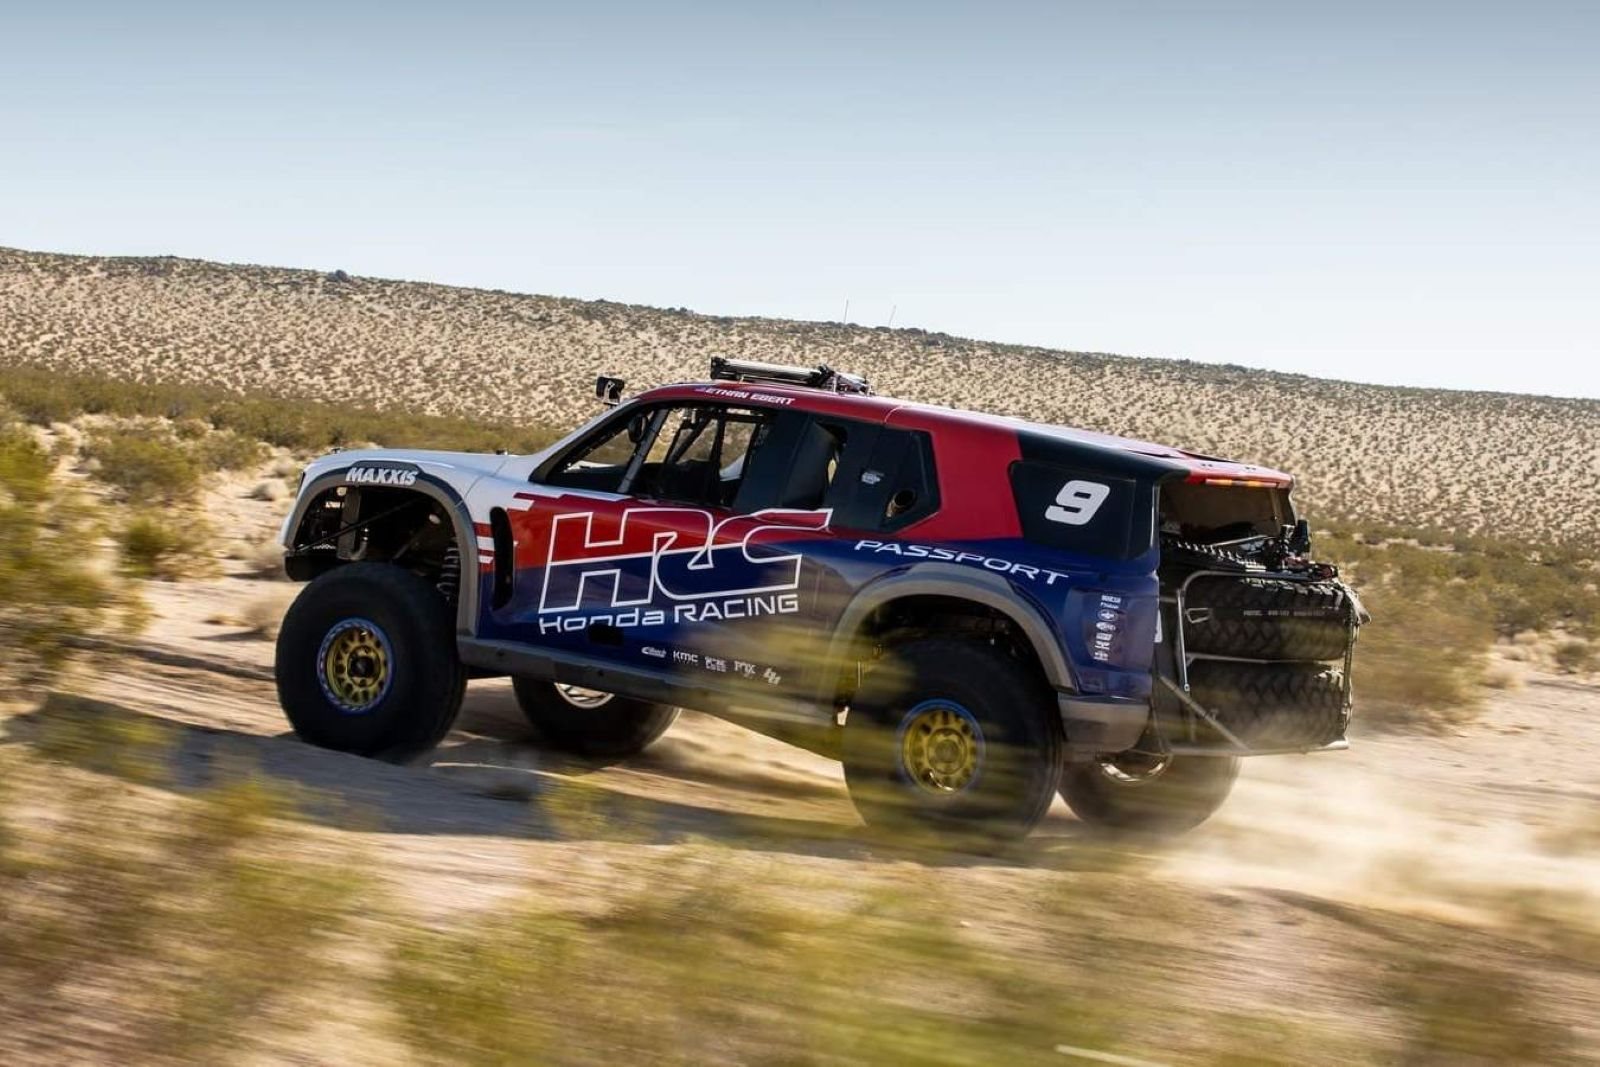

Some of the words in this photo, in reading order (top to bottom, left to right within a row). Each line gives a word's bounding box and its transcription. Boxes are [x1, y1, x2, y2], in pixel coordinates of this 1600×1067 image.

[345, 467, 420, 486] MAXXIS
[1044, 480, 1111, 526] 9
[854, 539, 1069, 585] PASSPORT
[538, 607, 664, 635] Honda
[674, 593, 799, 624] RACING
